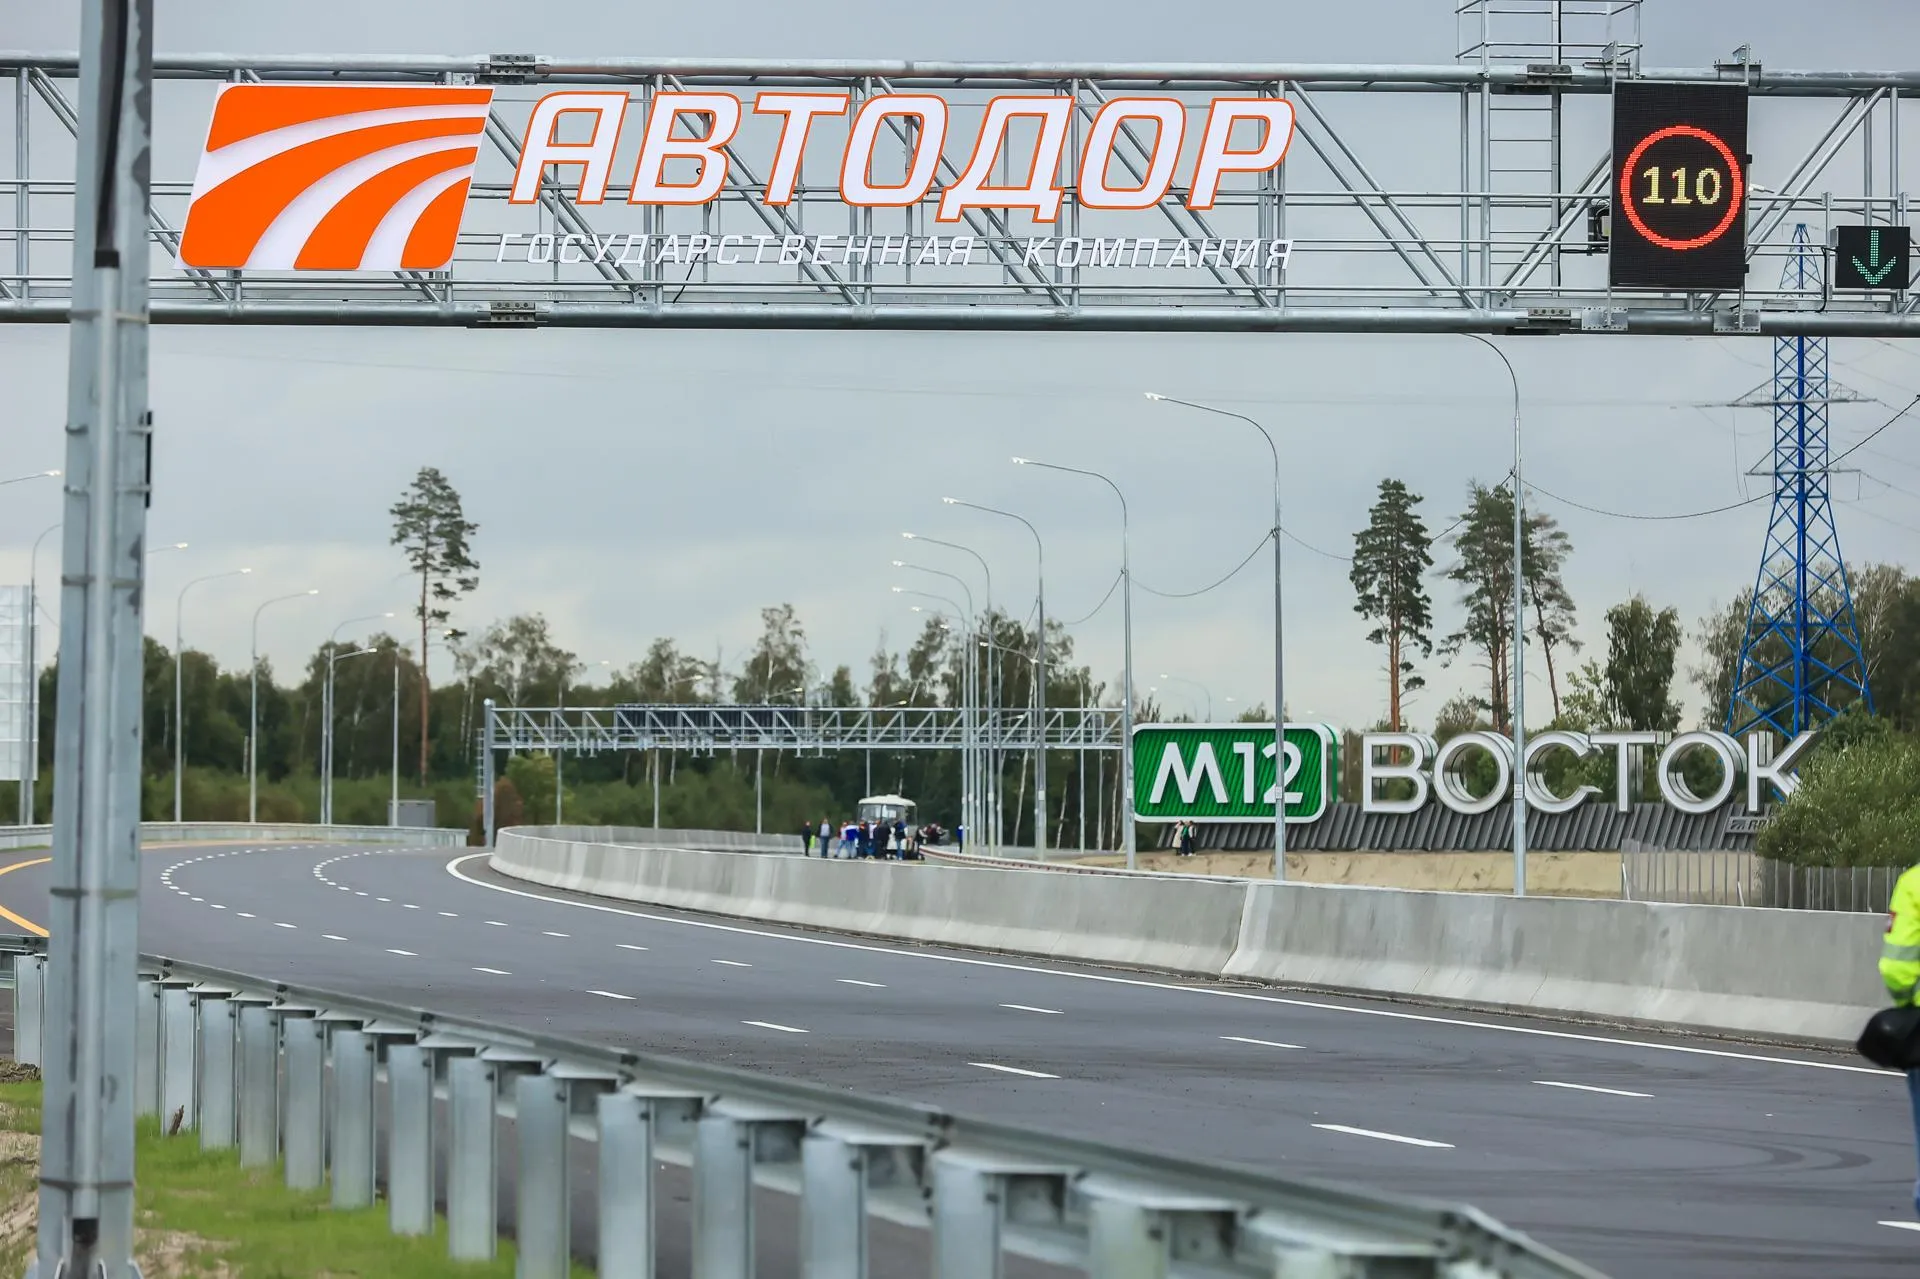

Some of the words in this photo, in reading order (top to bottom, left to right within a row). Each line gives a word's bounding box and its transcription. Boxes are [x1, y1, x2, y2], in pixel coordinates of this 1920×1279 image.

[508, 91, 1295, 223] АВТОДОР
[1642, 166, 1722, 204] 110
[496, 233, 974, 268] ГОСУДАРСТВЕННАЯ
[1022, 236, 1294, 270] КОМПАНИЯ
[1149, 741, 1303, 804] М12
[1362, 731, 1818, 814] ВОСТОК
